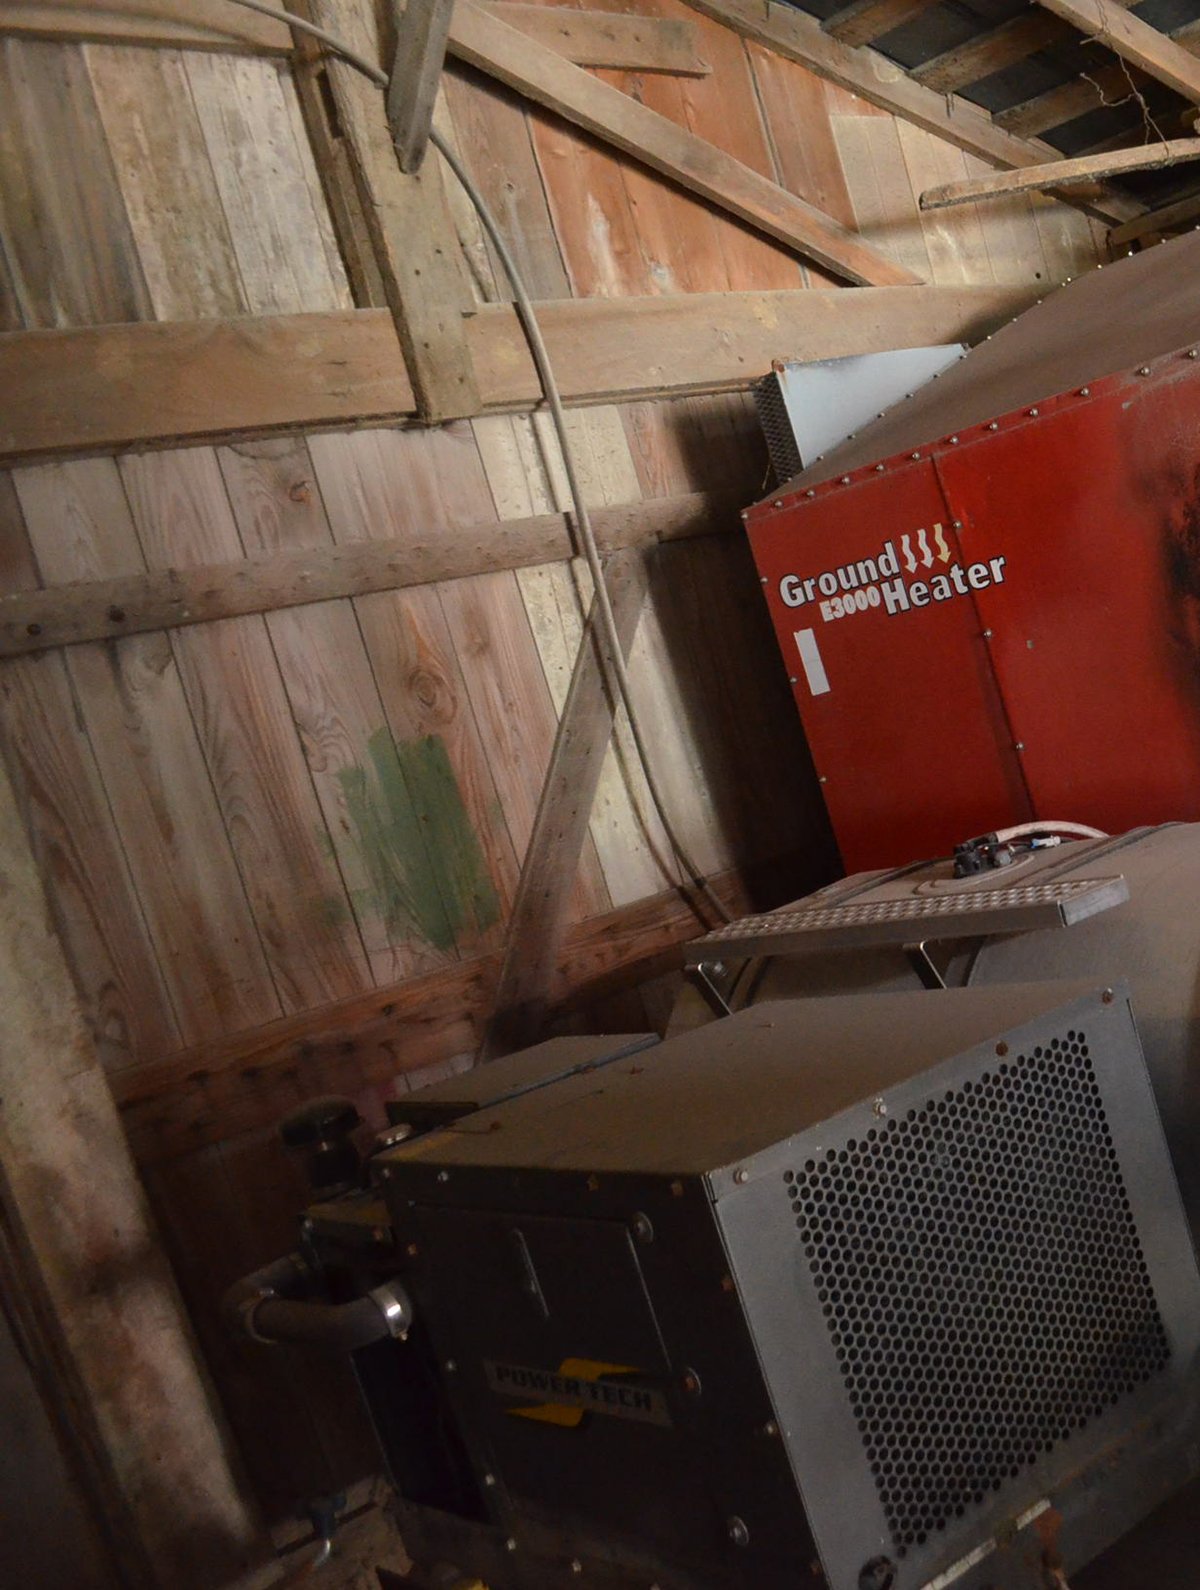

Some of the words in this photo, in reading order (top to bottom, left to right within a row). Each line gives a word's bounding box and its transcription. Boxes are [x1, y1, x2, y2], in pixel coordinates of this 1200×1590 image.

[779, 540, 900, 608] Ground
[819, 585, 881, 622] E3000
[881, 556, 1006, 615] Heater
